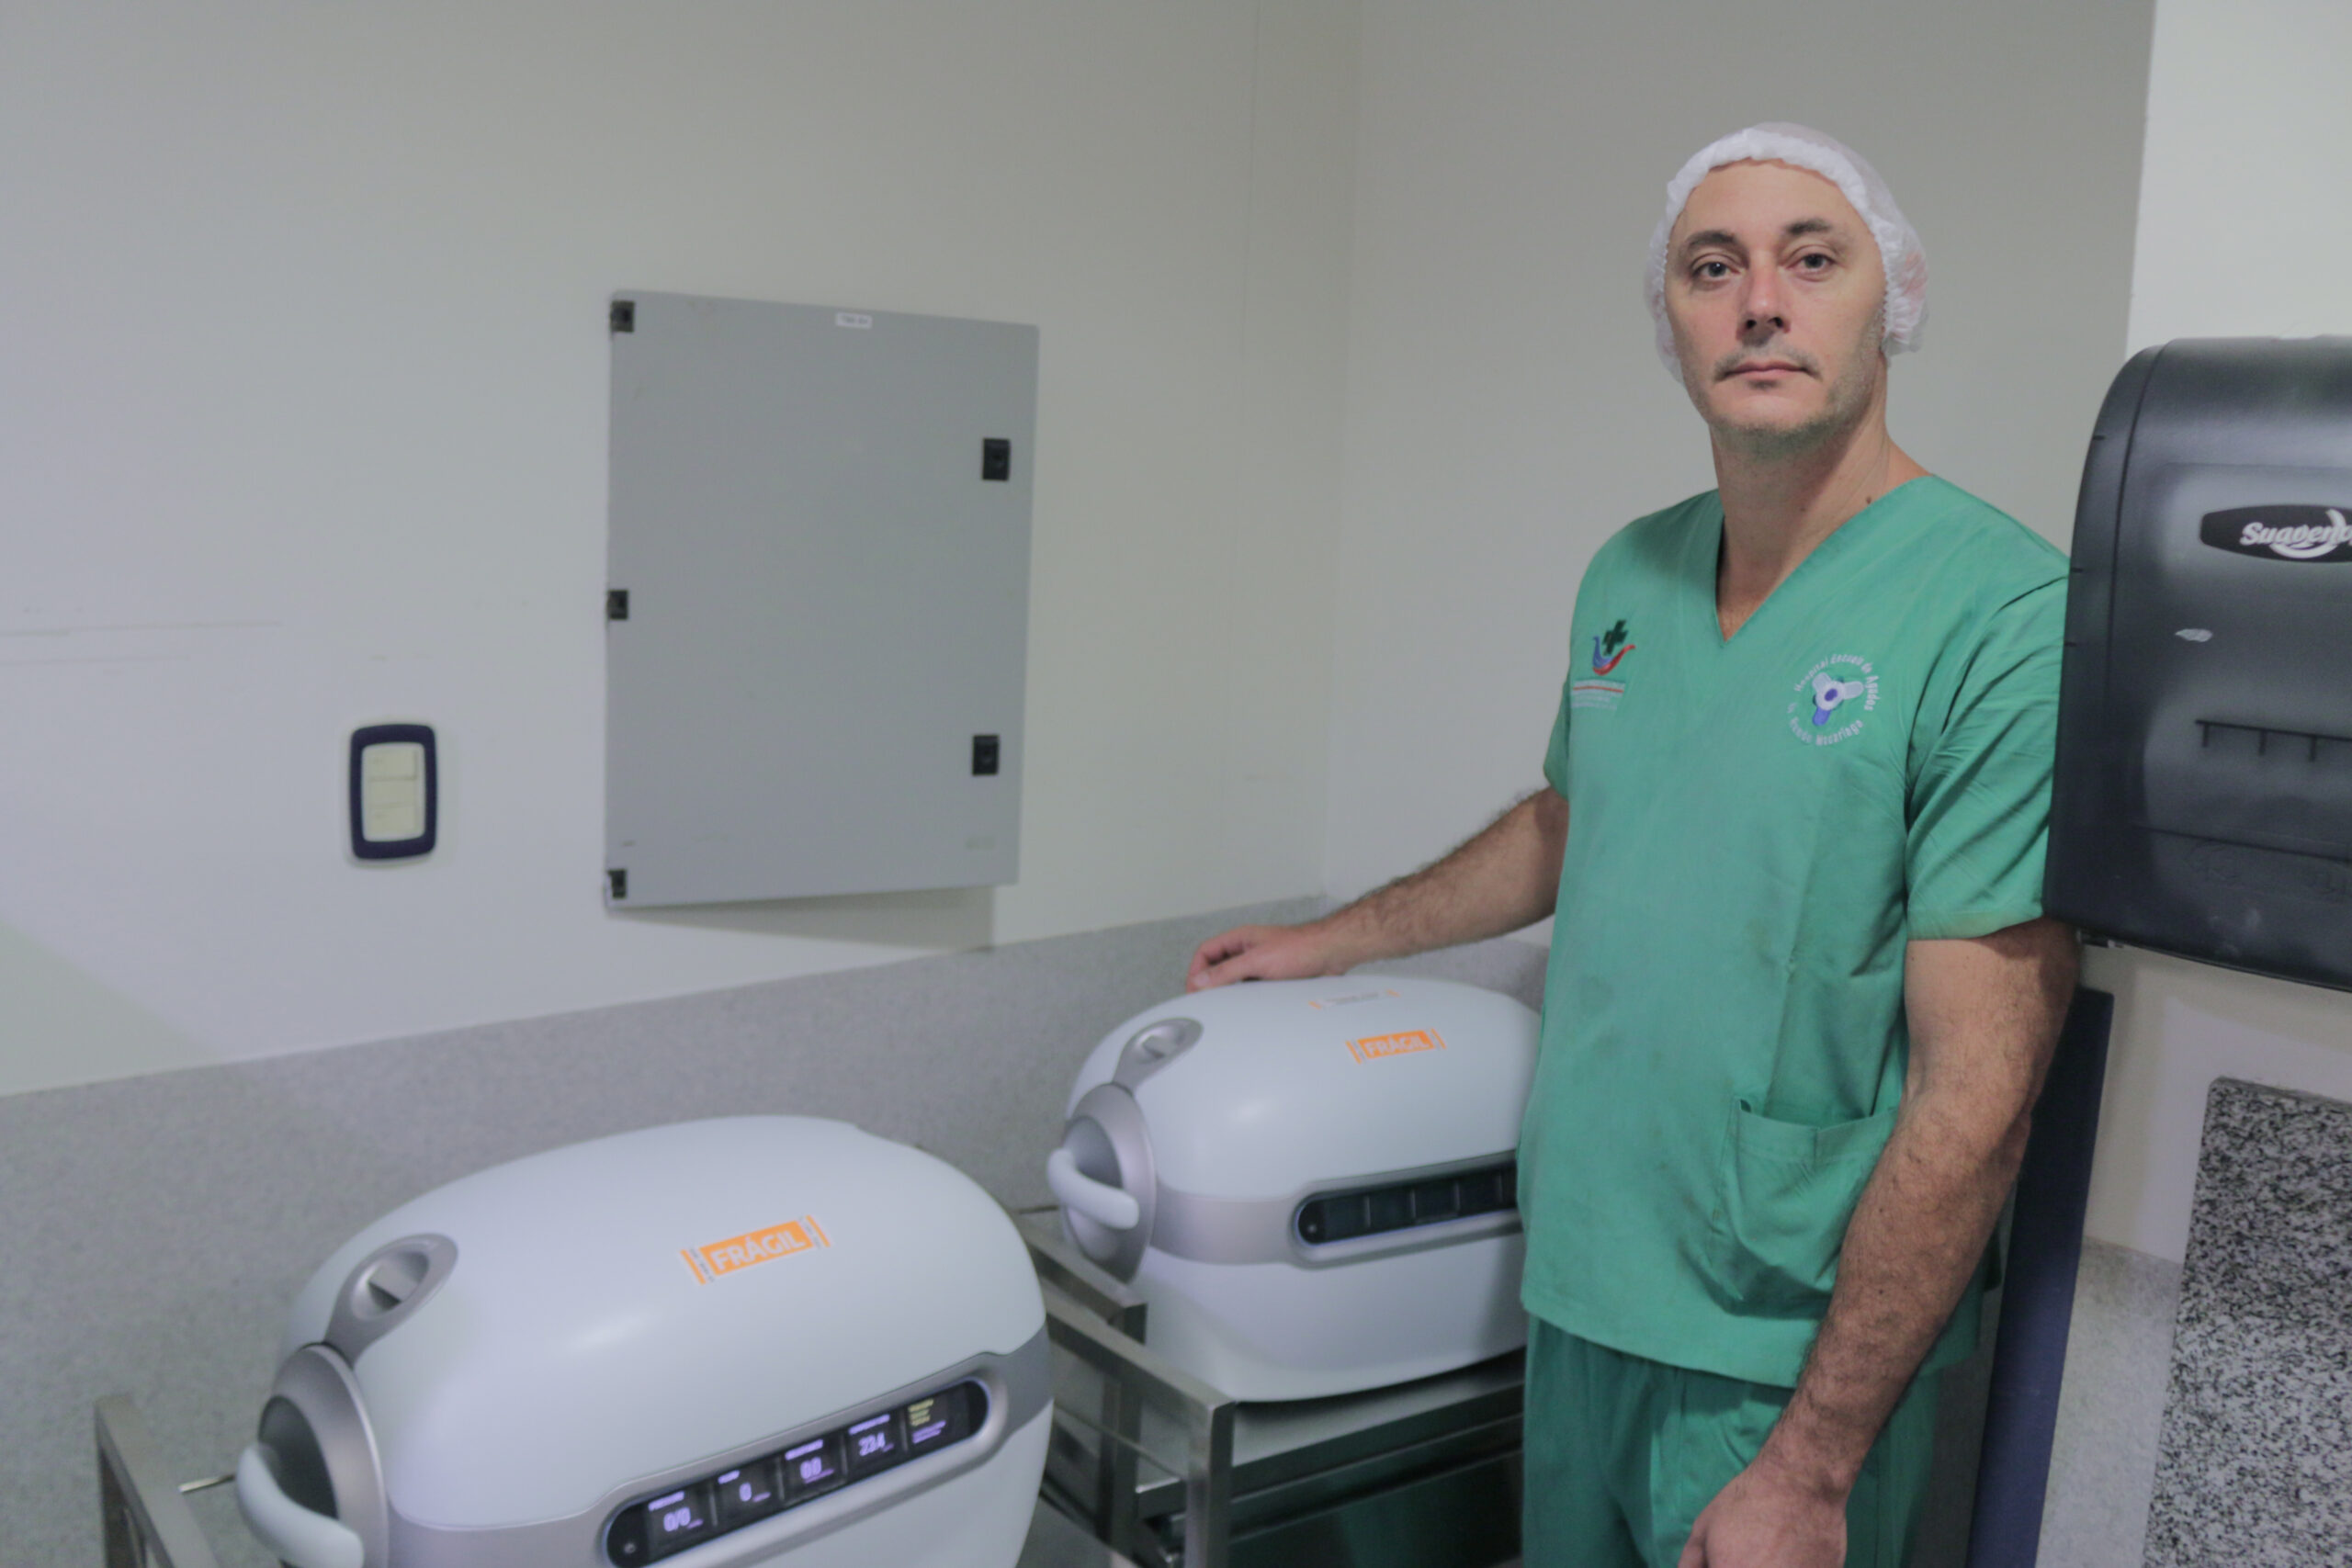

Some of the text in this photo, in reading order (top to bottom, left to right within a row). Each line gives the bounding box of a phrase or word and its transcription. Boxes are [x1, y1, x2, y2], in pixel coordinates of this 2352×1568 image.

[1864, 675, 1881, 711] Agudos
[1364, 1034, 1430, 1055] FRÁGIL
[710, 1230, 807, 1271] FRÁGIL
